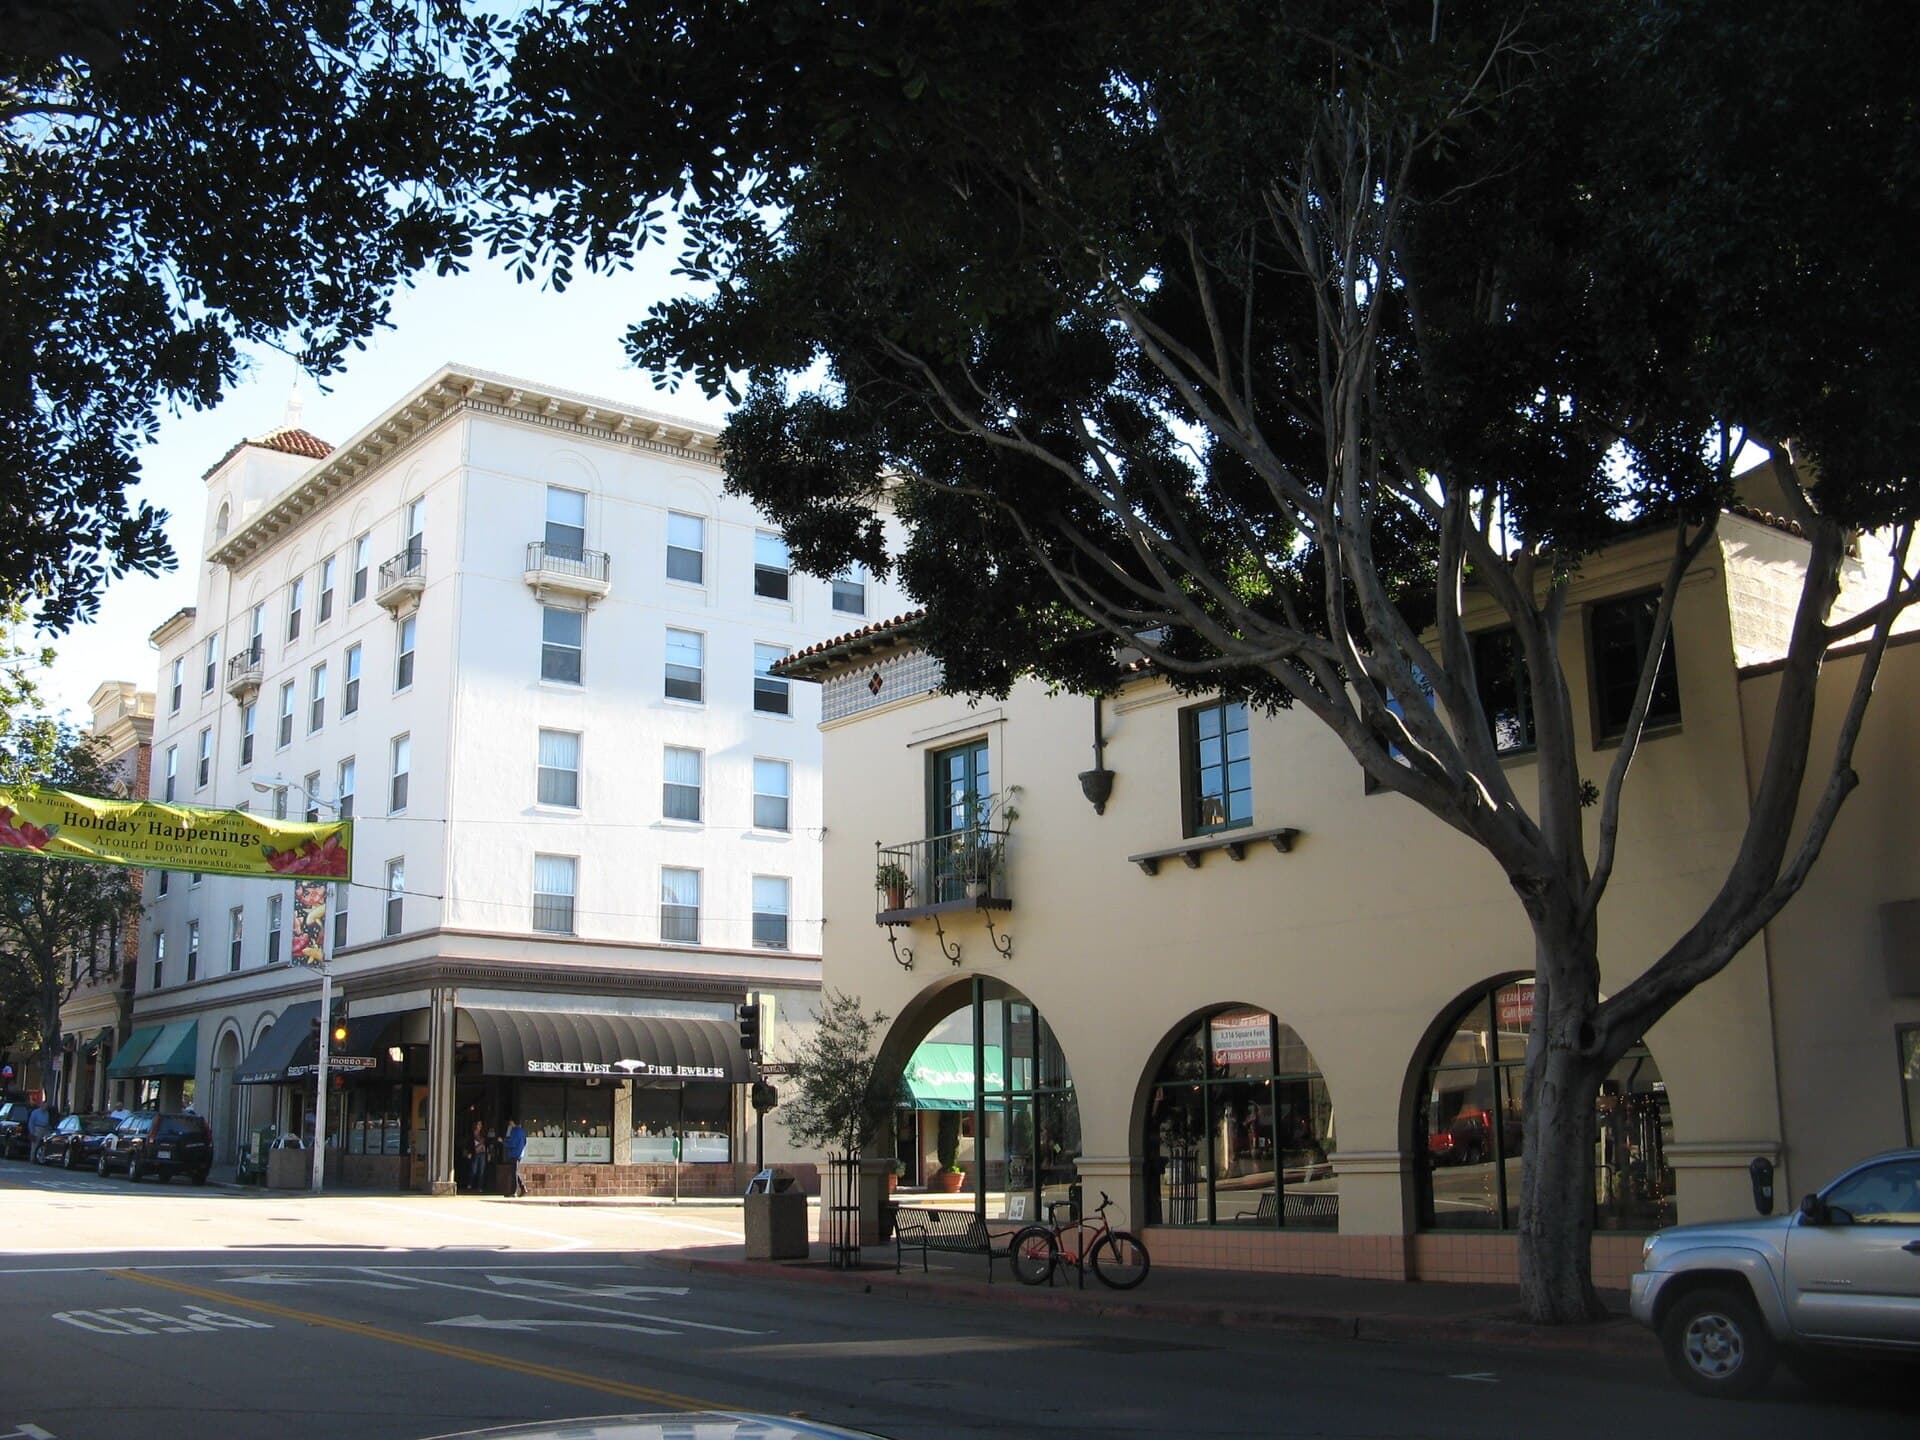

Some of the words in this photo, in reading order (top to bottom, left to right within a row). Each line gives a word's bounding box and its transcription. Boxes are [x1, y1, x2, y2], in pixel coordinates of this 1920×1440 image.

[47, 798, 75, 809] House
[64, 811, 141, 836] Holiday
[149, 820, 261, 847] Happenings
[95, 834, 148, 850] Around
[154, 840, 229, 858] Downtown
[583, 1062, 611, 1074] WEST
[648, 1064, 673, 1076] FINE
[676, 1065, 725, 1079] JEWELERS
